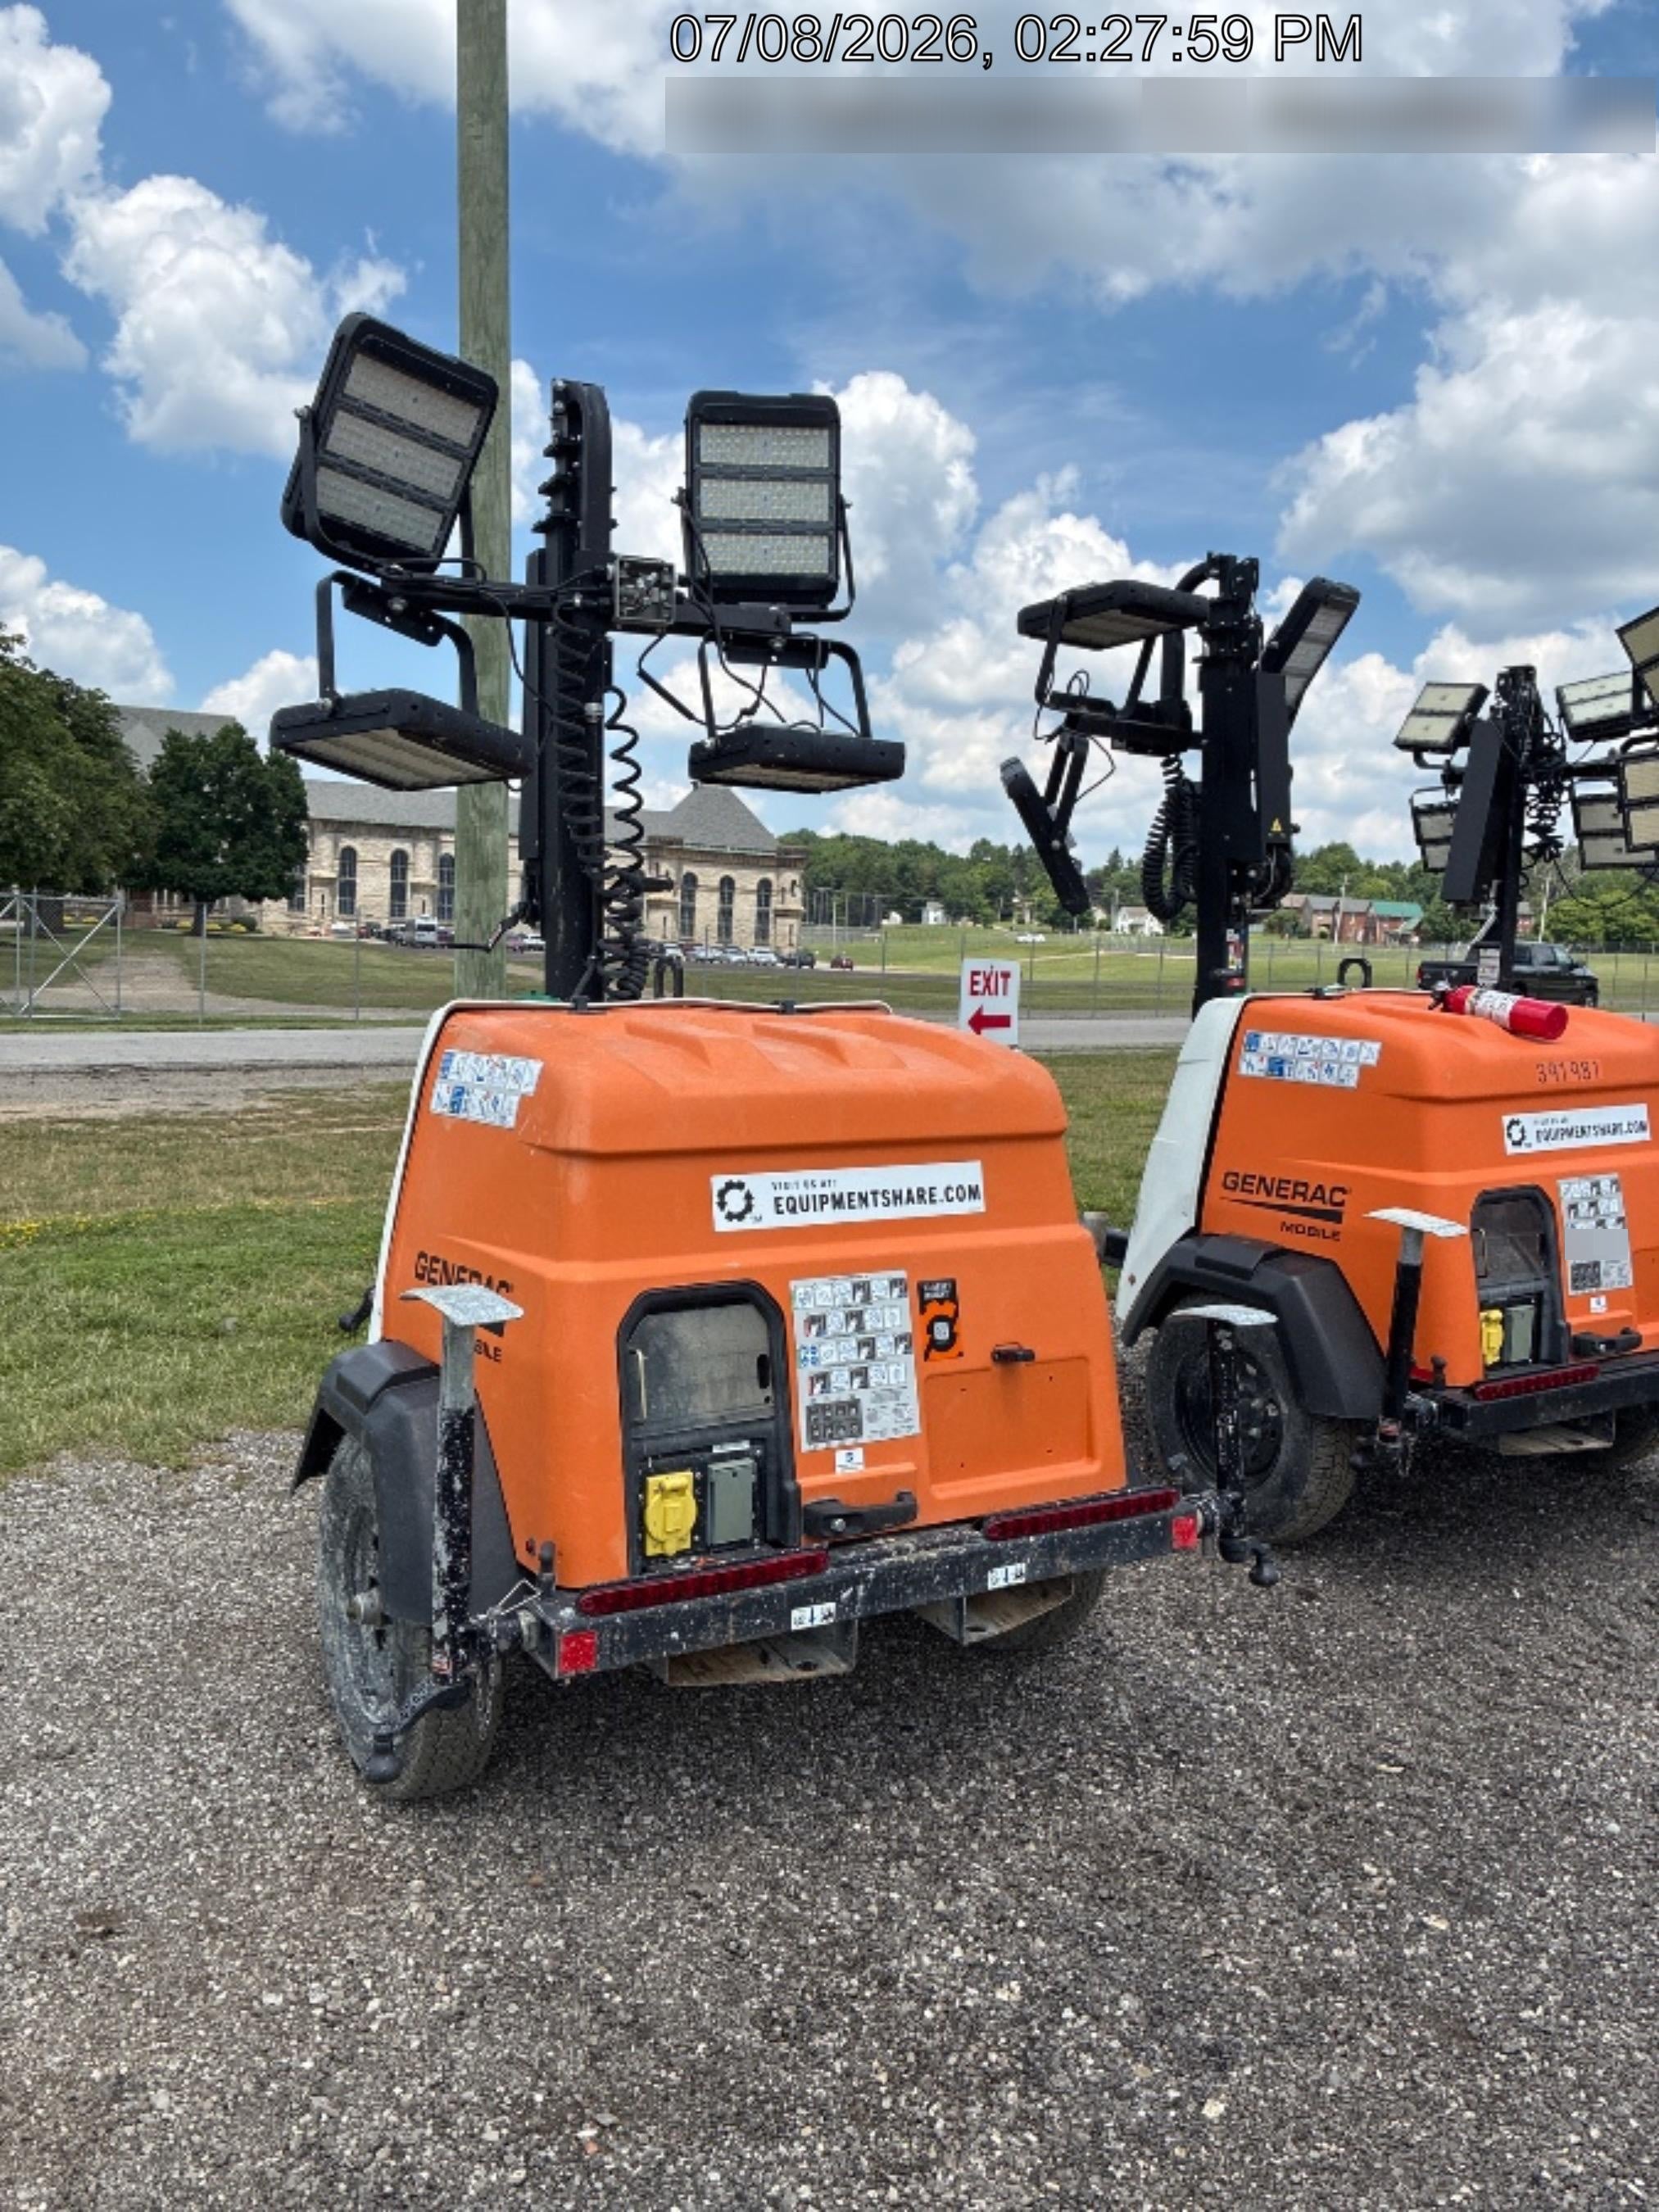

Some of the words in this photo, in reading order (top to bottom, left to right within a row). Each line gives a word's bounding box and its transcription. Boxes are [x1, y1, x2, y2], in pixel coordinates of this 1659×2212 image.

[970, 970, 1011, 996] EXIT
[773, 1184, 981, 1215] EQUIPMENTSHARE.COM
[1222, 1172, 1348, 1207] GENERAC
[1281, 1221, 1340, 1241] MOBILE
